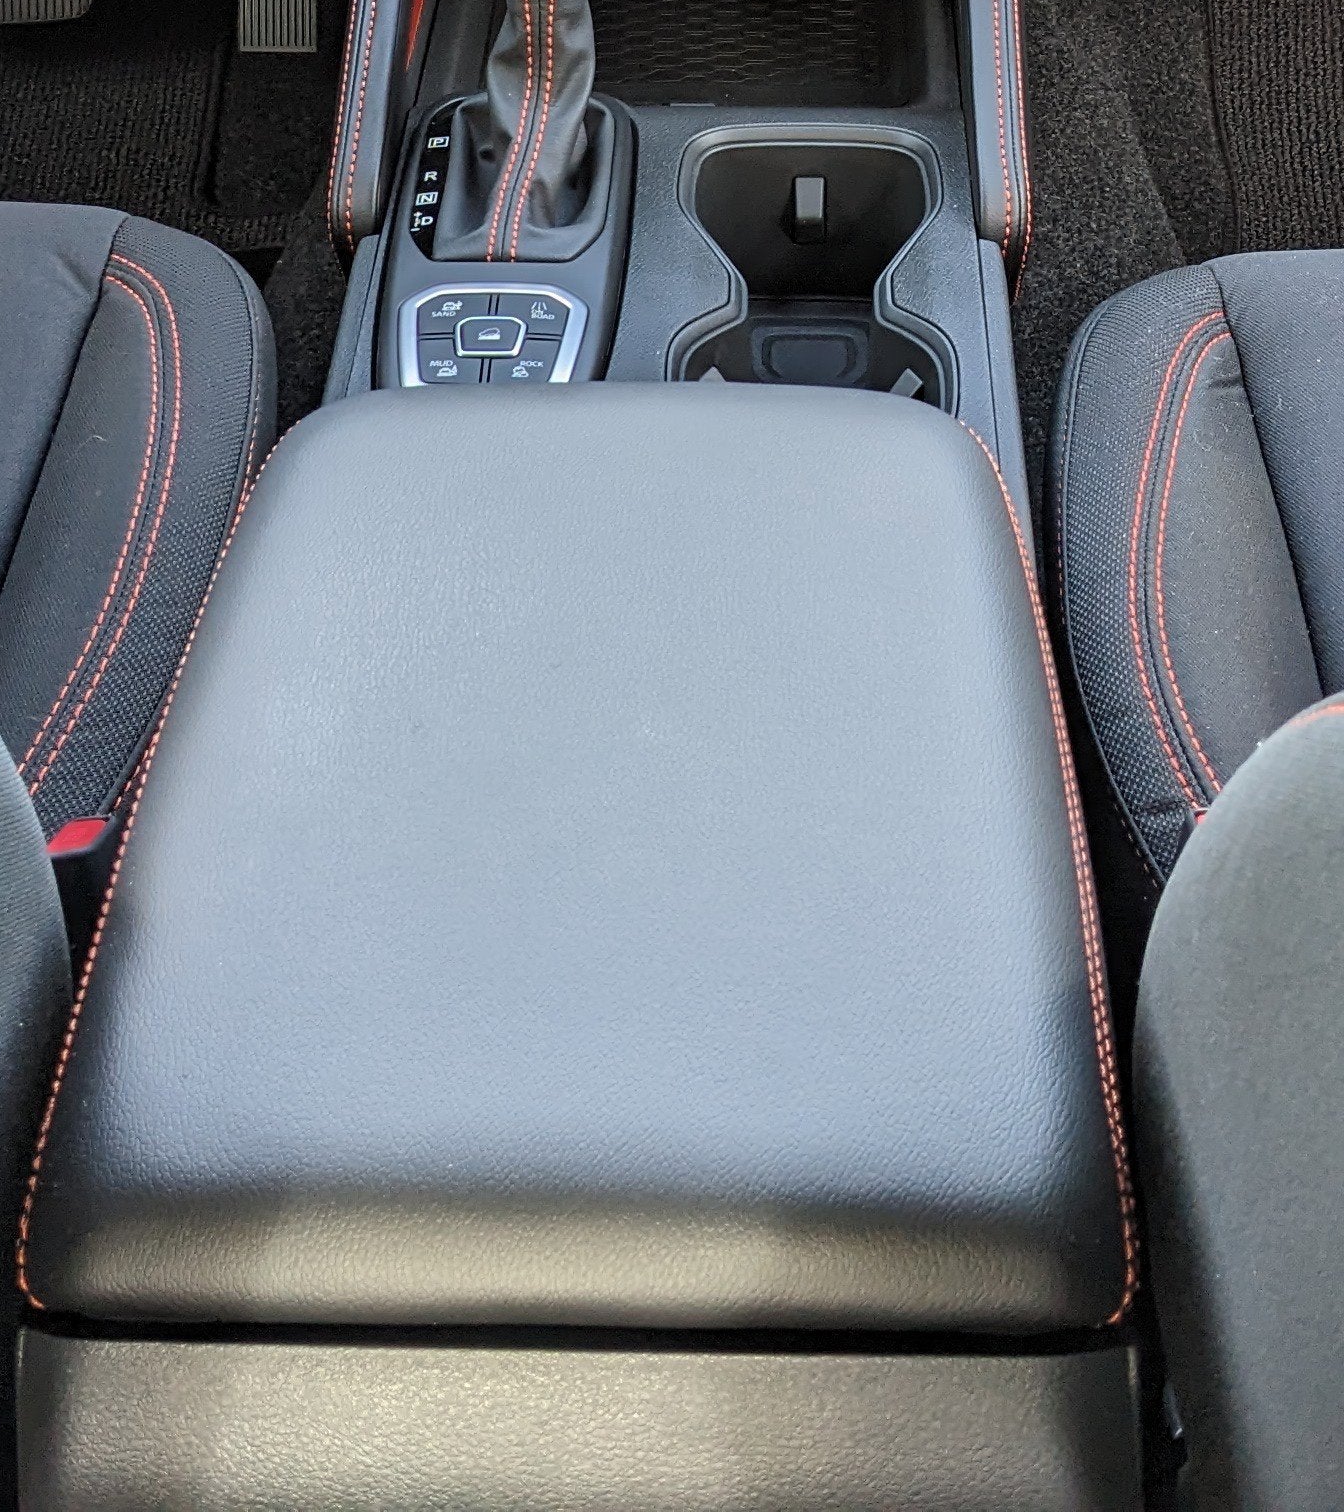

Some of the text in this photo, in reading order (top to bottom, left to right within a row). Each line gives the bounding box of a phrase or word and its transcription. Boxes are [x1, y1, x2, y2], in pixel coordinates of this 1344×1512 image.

[424, 171, 438, 181] R
[420, 216, 434, 226] D
[429, 359, 453, 367] MUD
[519, 360, 544, 368] ROCK
